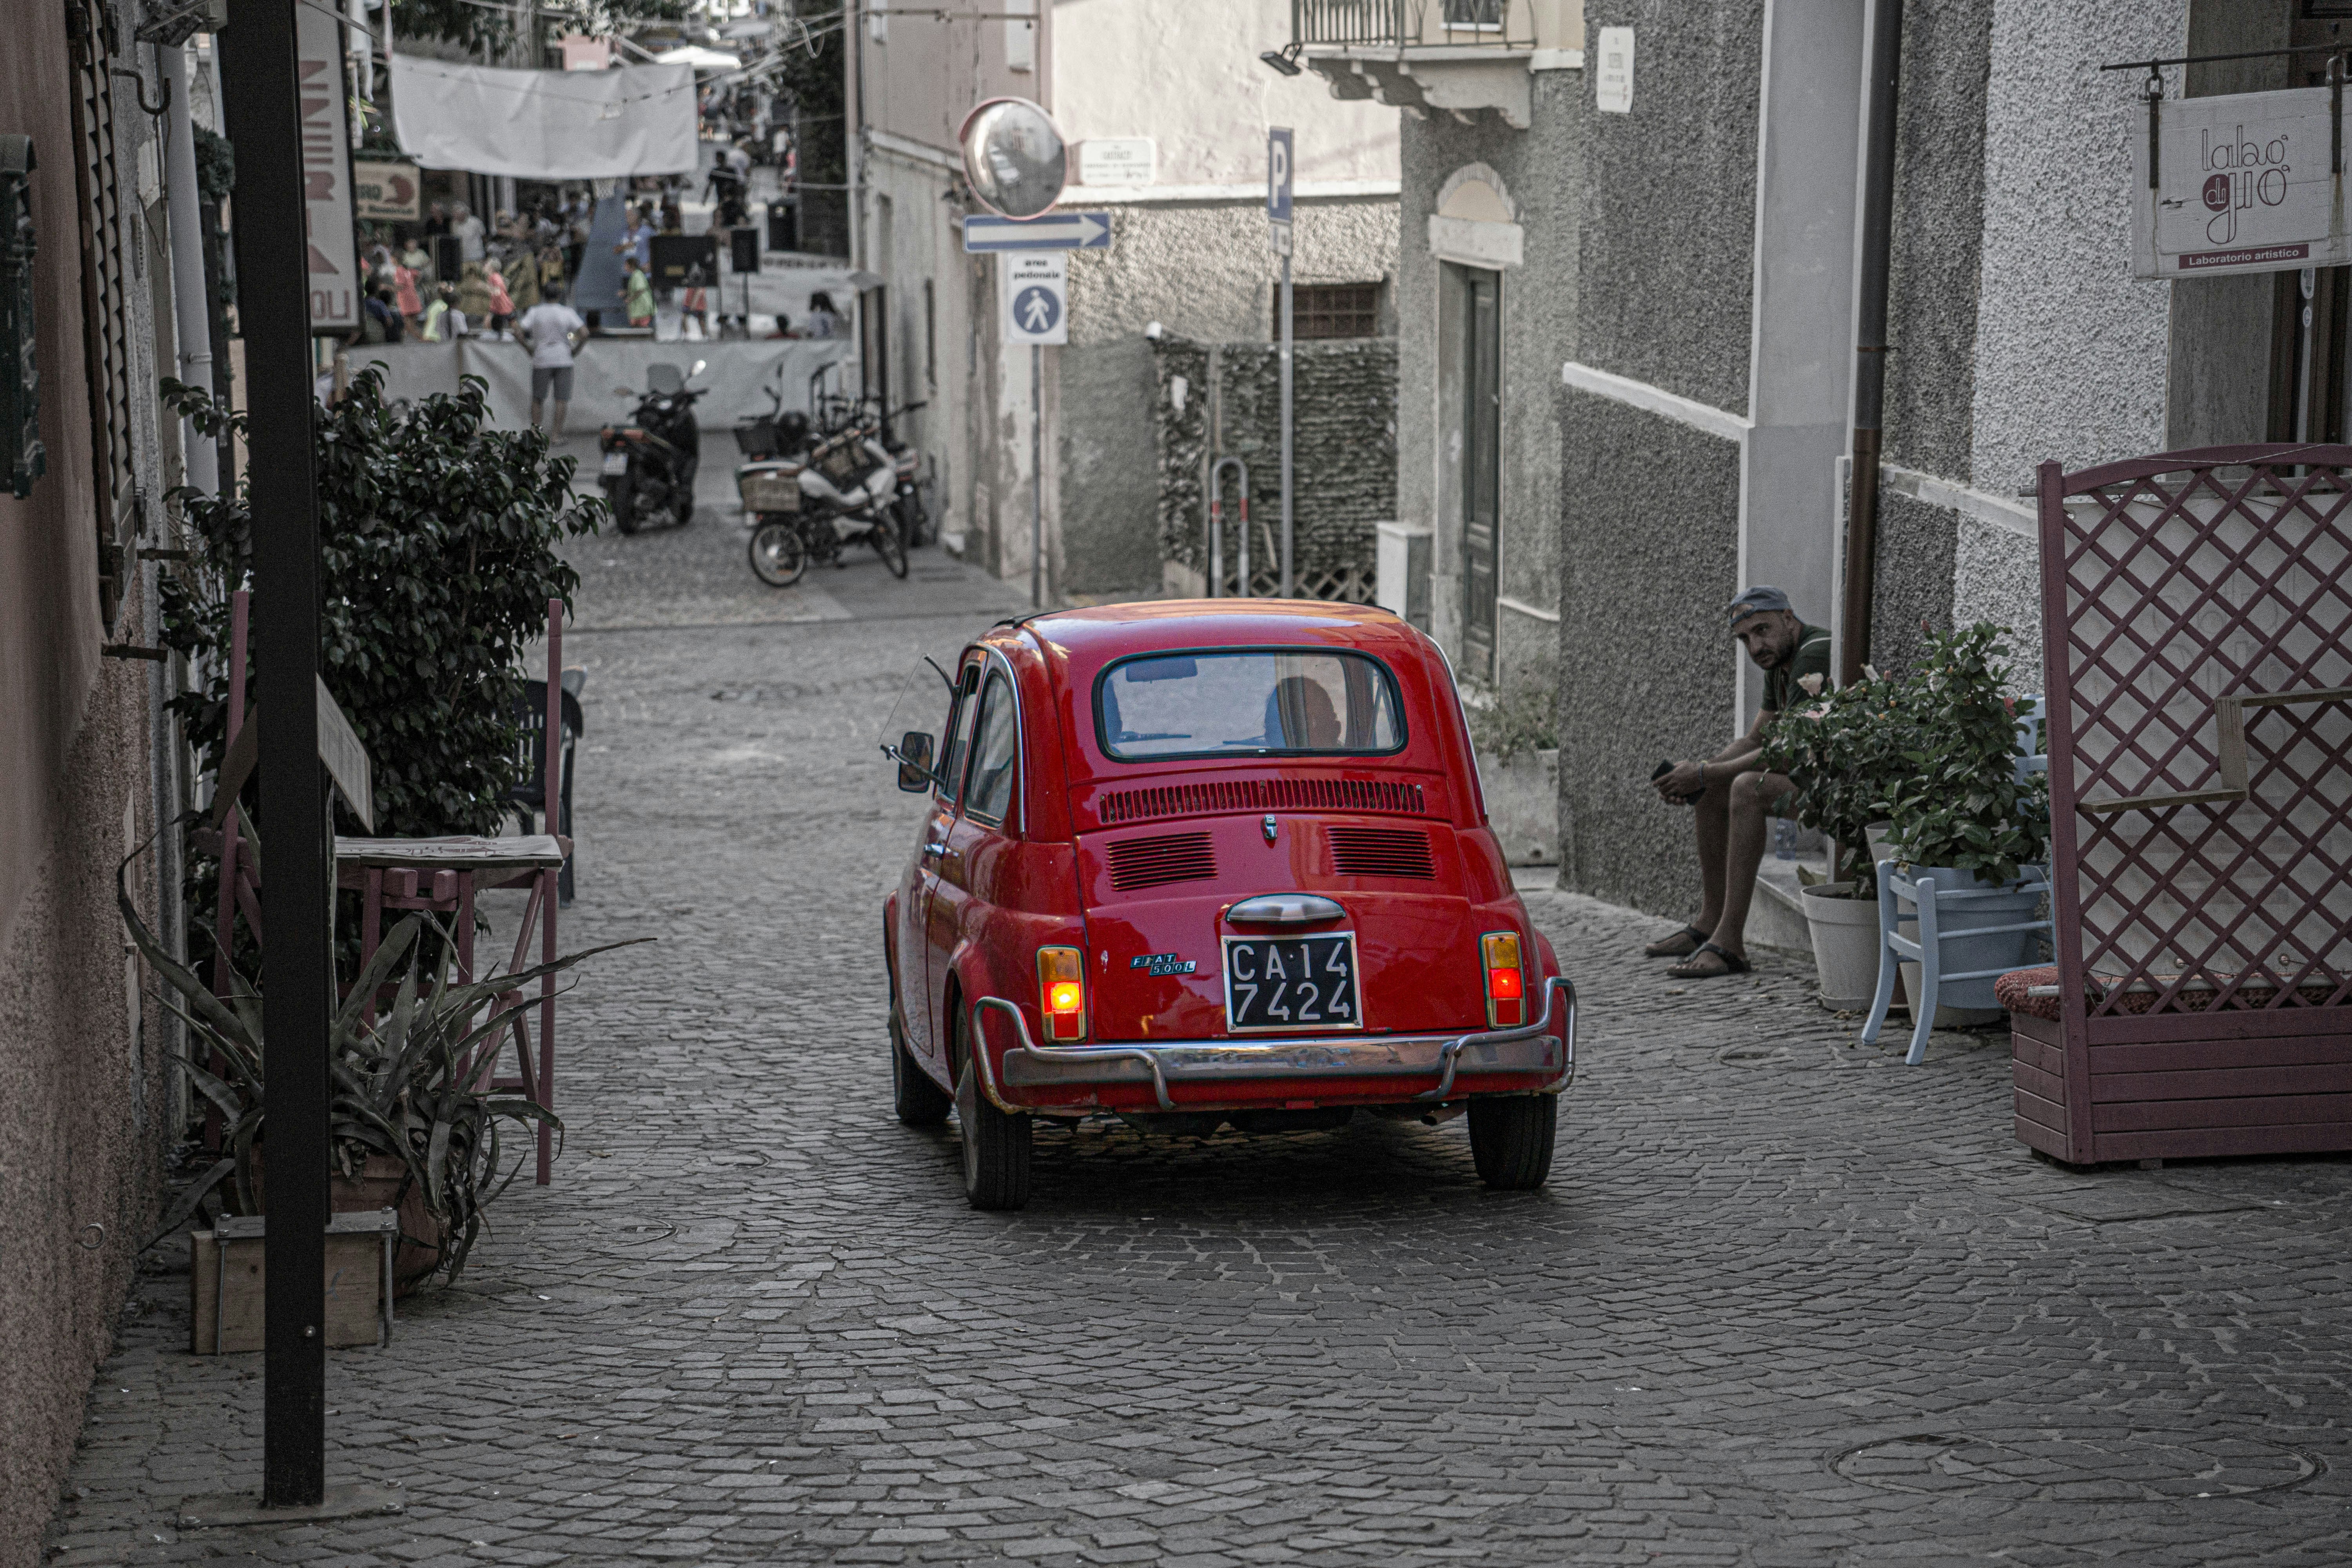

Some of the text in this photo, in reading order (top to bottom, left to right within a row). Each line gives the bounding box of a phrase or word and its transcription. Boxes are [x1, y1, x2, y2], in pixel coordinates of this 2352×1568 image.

[1271, 140, 1288, 209] P
[2189, 249, 2299, 266] Laboratorio artistico
[1014, 270, 1060, 280] pedonale
[1134, 954, 1174, 966] FIAT
[1154, 960, 1196, 973] 500L
[1234, 980, 1350, 1022] 7424
